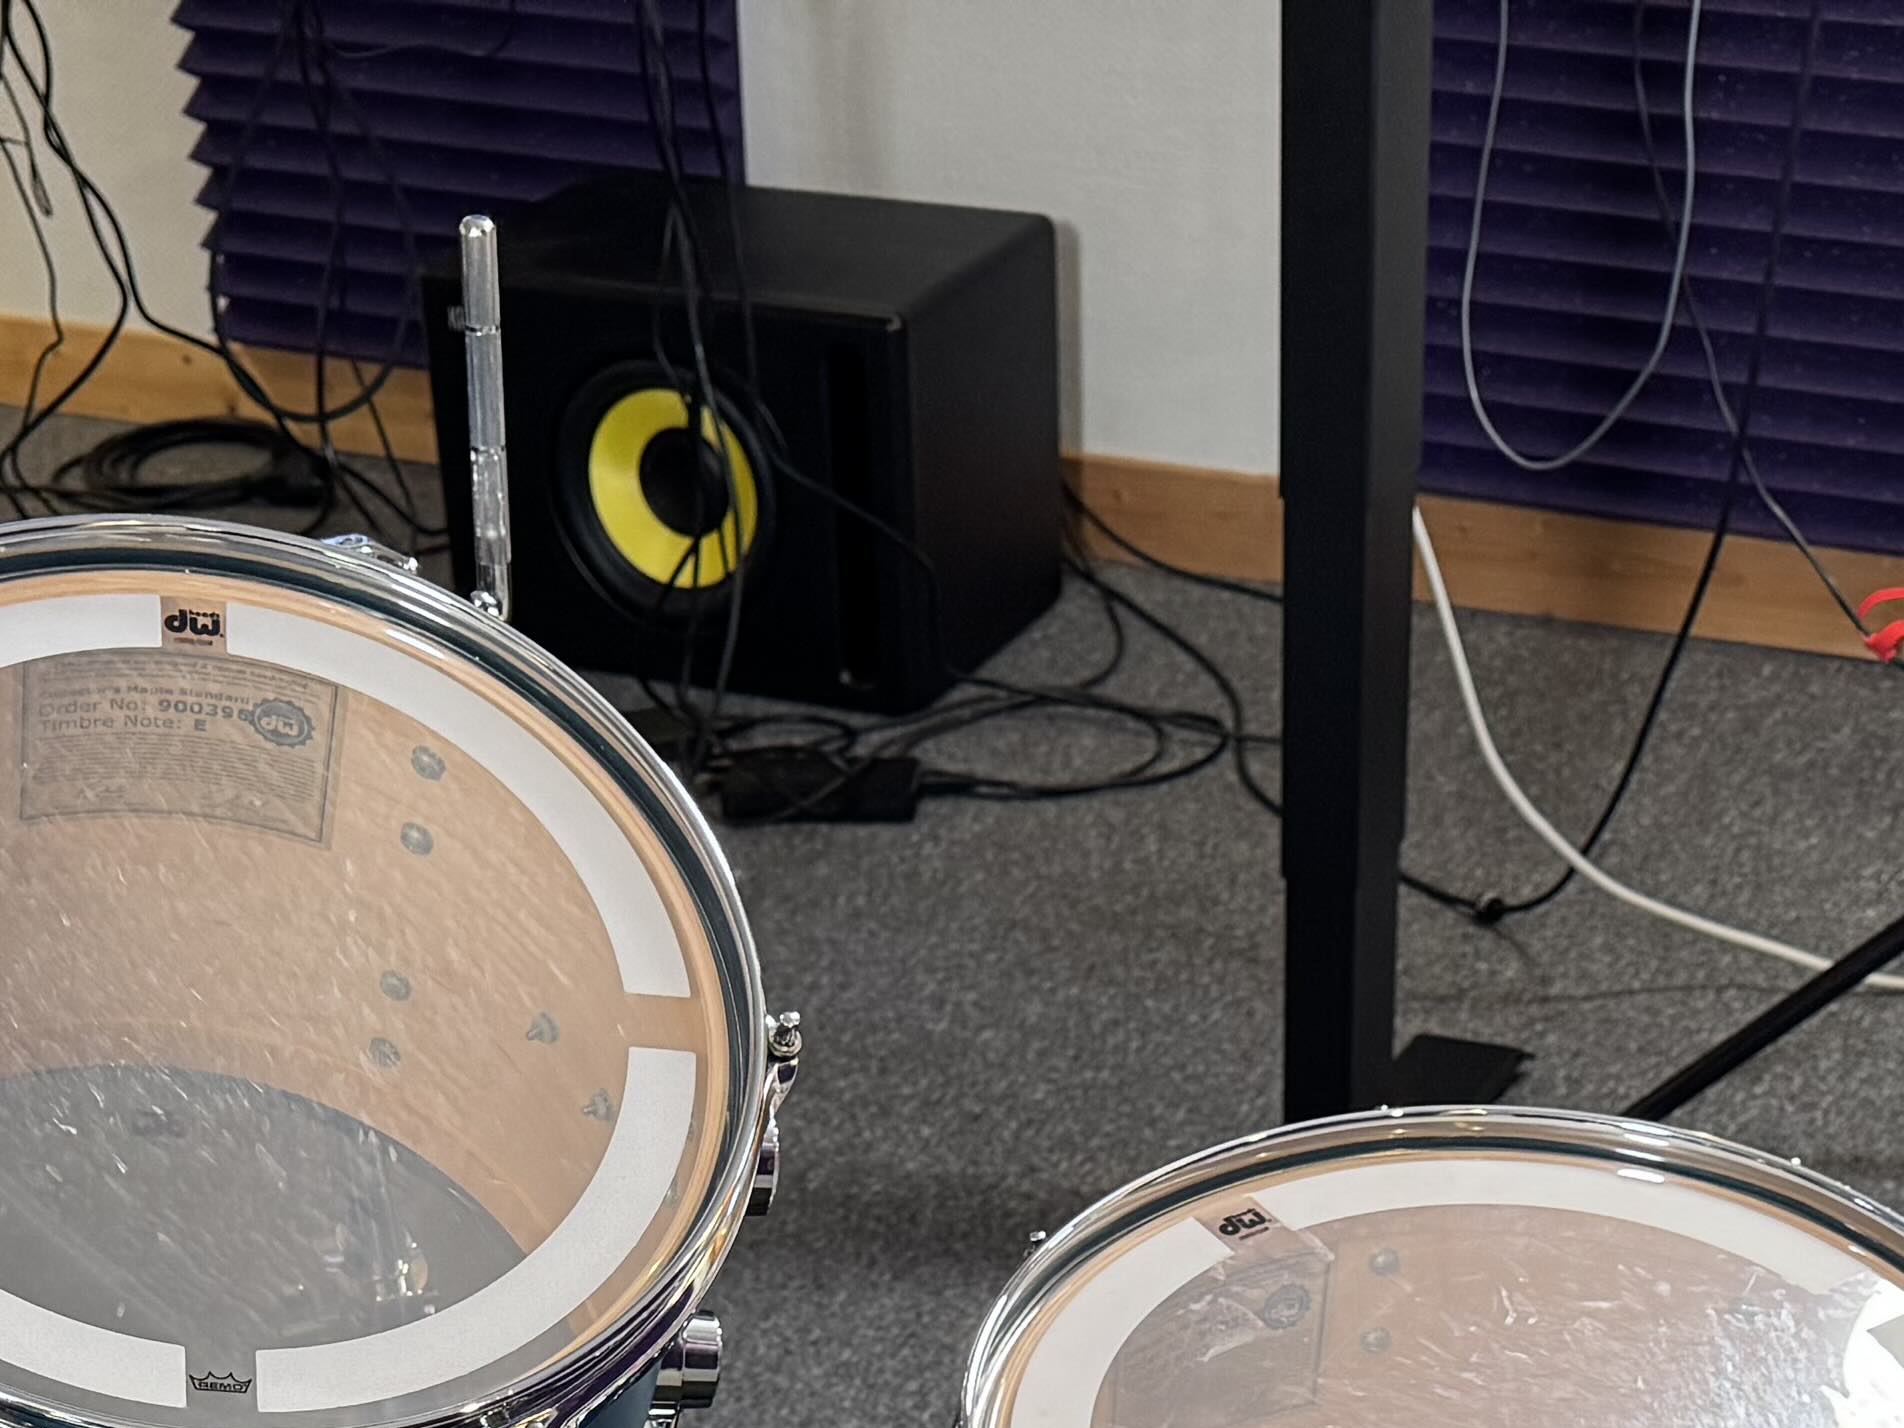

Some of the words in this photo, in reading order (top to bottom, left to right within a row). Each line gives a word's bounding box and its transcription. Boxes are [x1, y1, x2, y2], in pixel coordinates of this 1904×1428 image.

[38, 699, 98, 718] Order
[109, 698, 146, 713] No:
[39, 715, 114, 734] Timbre
[123, 714, 183, 731] Note:
[193, 718, 208, 733] E
